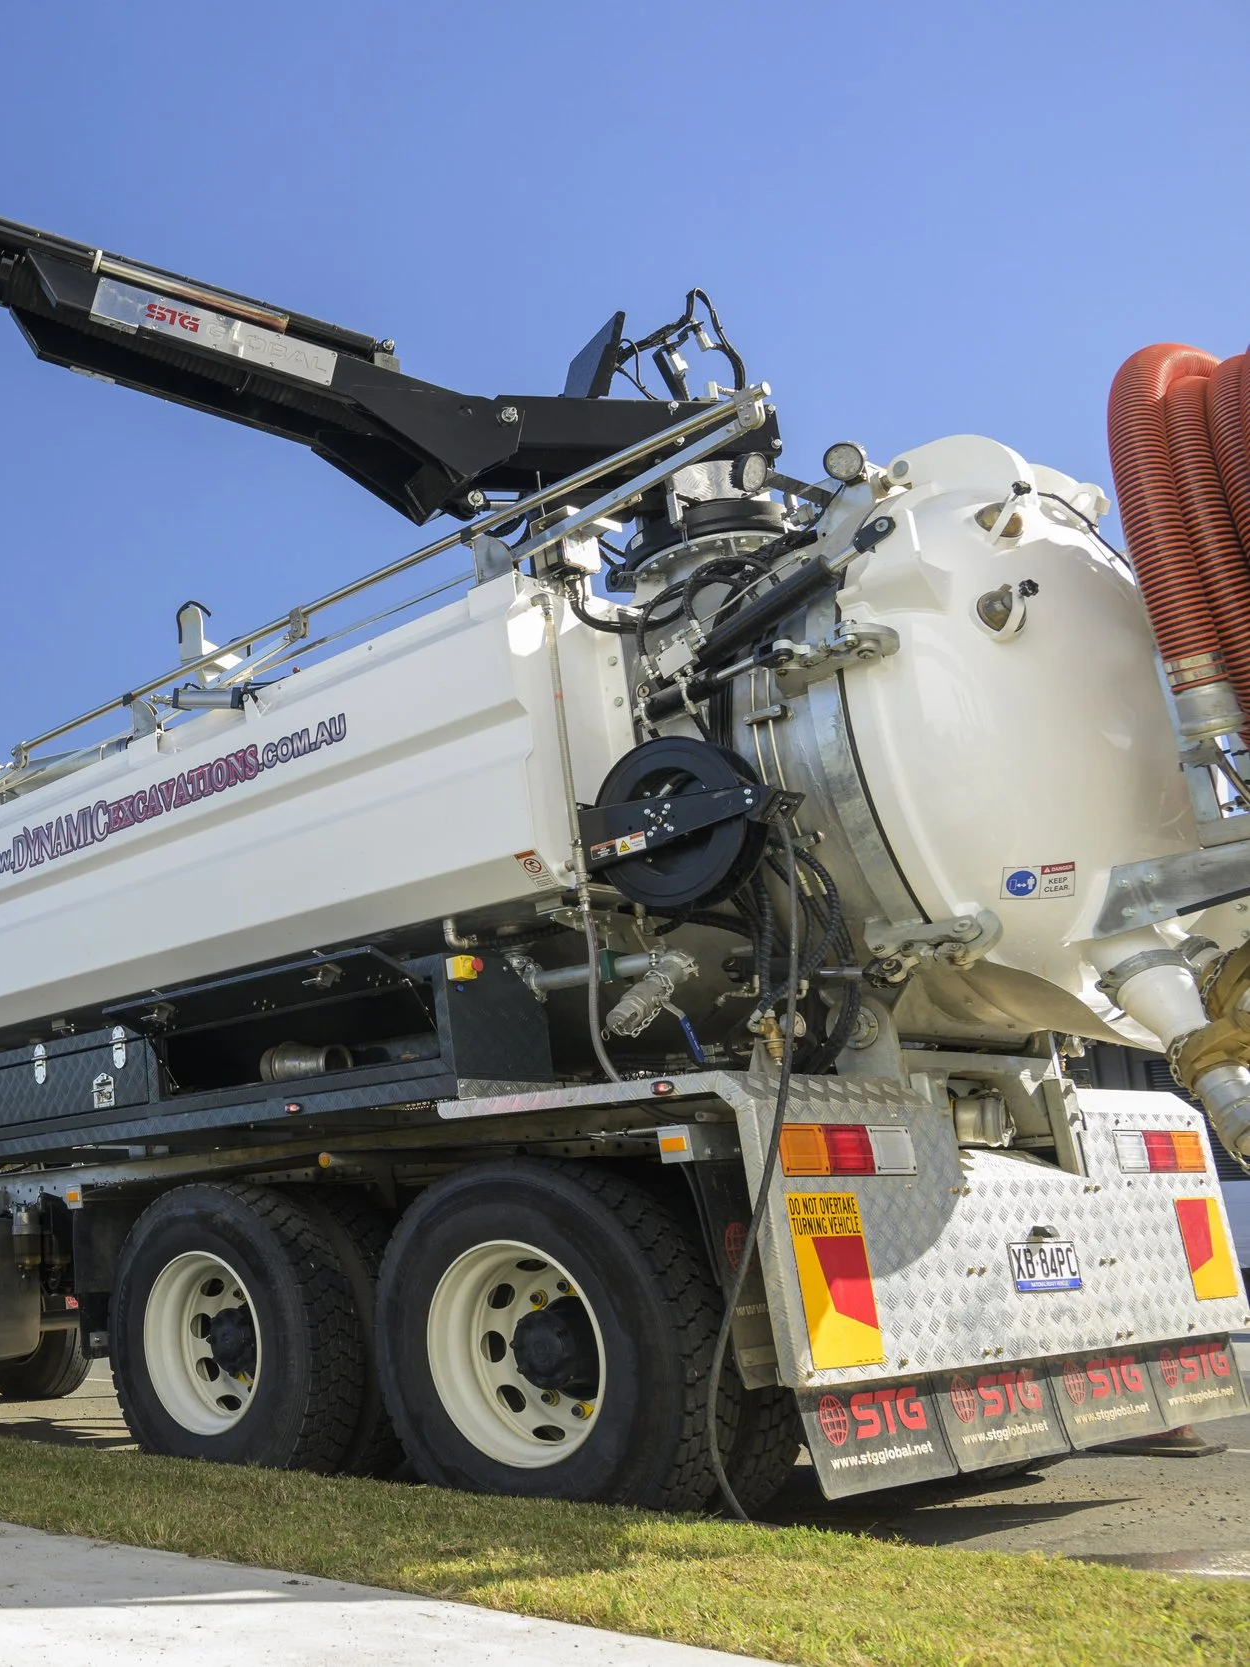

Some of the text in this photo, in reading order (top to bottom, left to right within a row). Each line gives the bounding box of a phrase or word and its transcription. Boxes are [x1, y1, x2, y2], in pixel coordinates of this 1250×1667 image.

[145, 303, 327, 373] STG GLOBAL
[1051, 864, 1073, 872] DANGER
[789, 1196, 858, 1215] DO NOT OVERTAKE
[792, 1216, 861, 1235] TURNING VEHICLE
[1086, 1356, 1144, 1400] STG
[1178, 1343, 1231, 1384] STG
[977, 1369, 1043, 1417] STG
[849, 1386, 927, 1440] STG
[1074, 1402, 1151, 1425] www.stgglobal.net
[961, 1421, 1049, 1446] www.stgglobal.net
[830, 1441, 934, 1471] www.stgglobal.net
